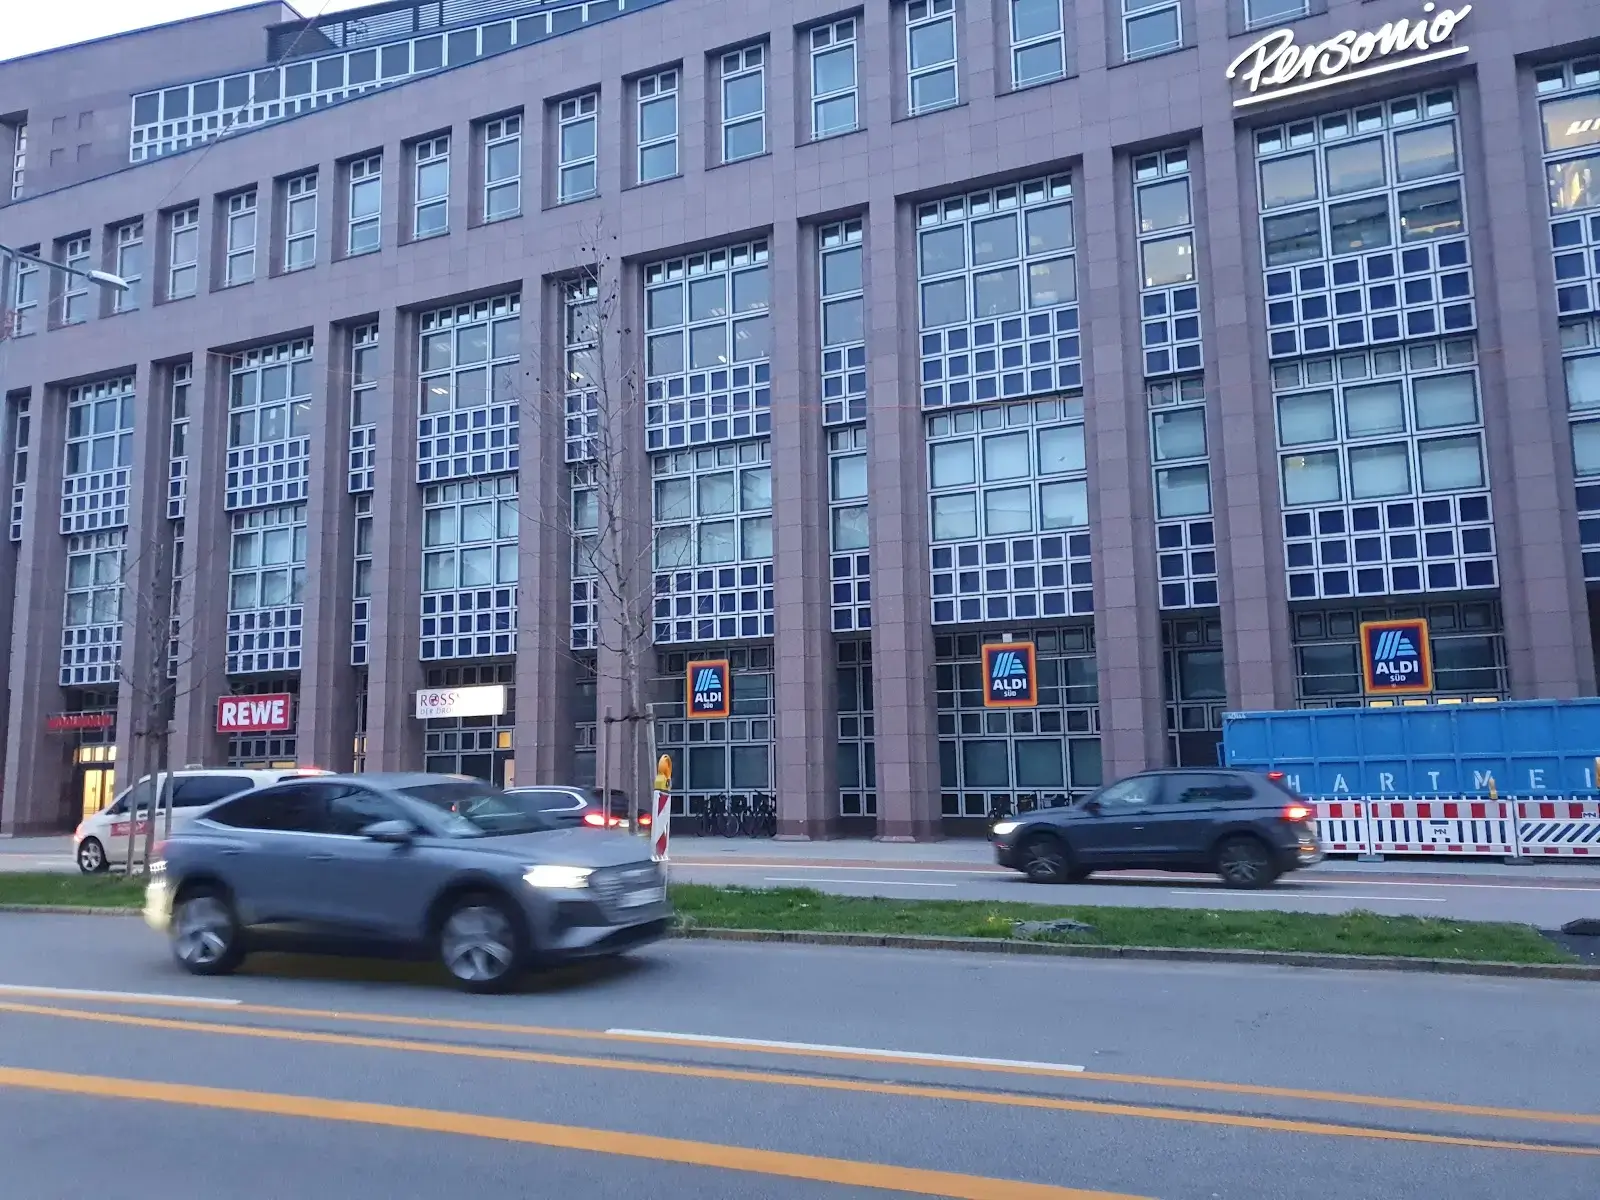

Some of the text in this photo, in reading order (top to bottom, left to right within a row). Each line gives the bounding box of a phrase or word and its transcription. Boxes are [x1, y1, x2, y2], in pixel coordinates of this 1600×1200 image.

[1226, 2, 1472, 91] Personio
[1376, 660, 1419, 675] ALDI
[992, 678, 1027, 691] ALDI
[1390, 674, 1406, 682] SÜD
[420, 693, 460, 707] ROSS
[694, 692, 722, 703] ALDI
[221, 700, 285, 726] REWE
